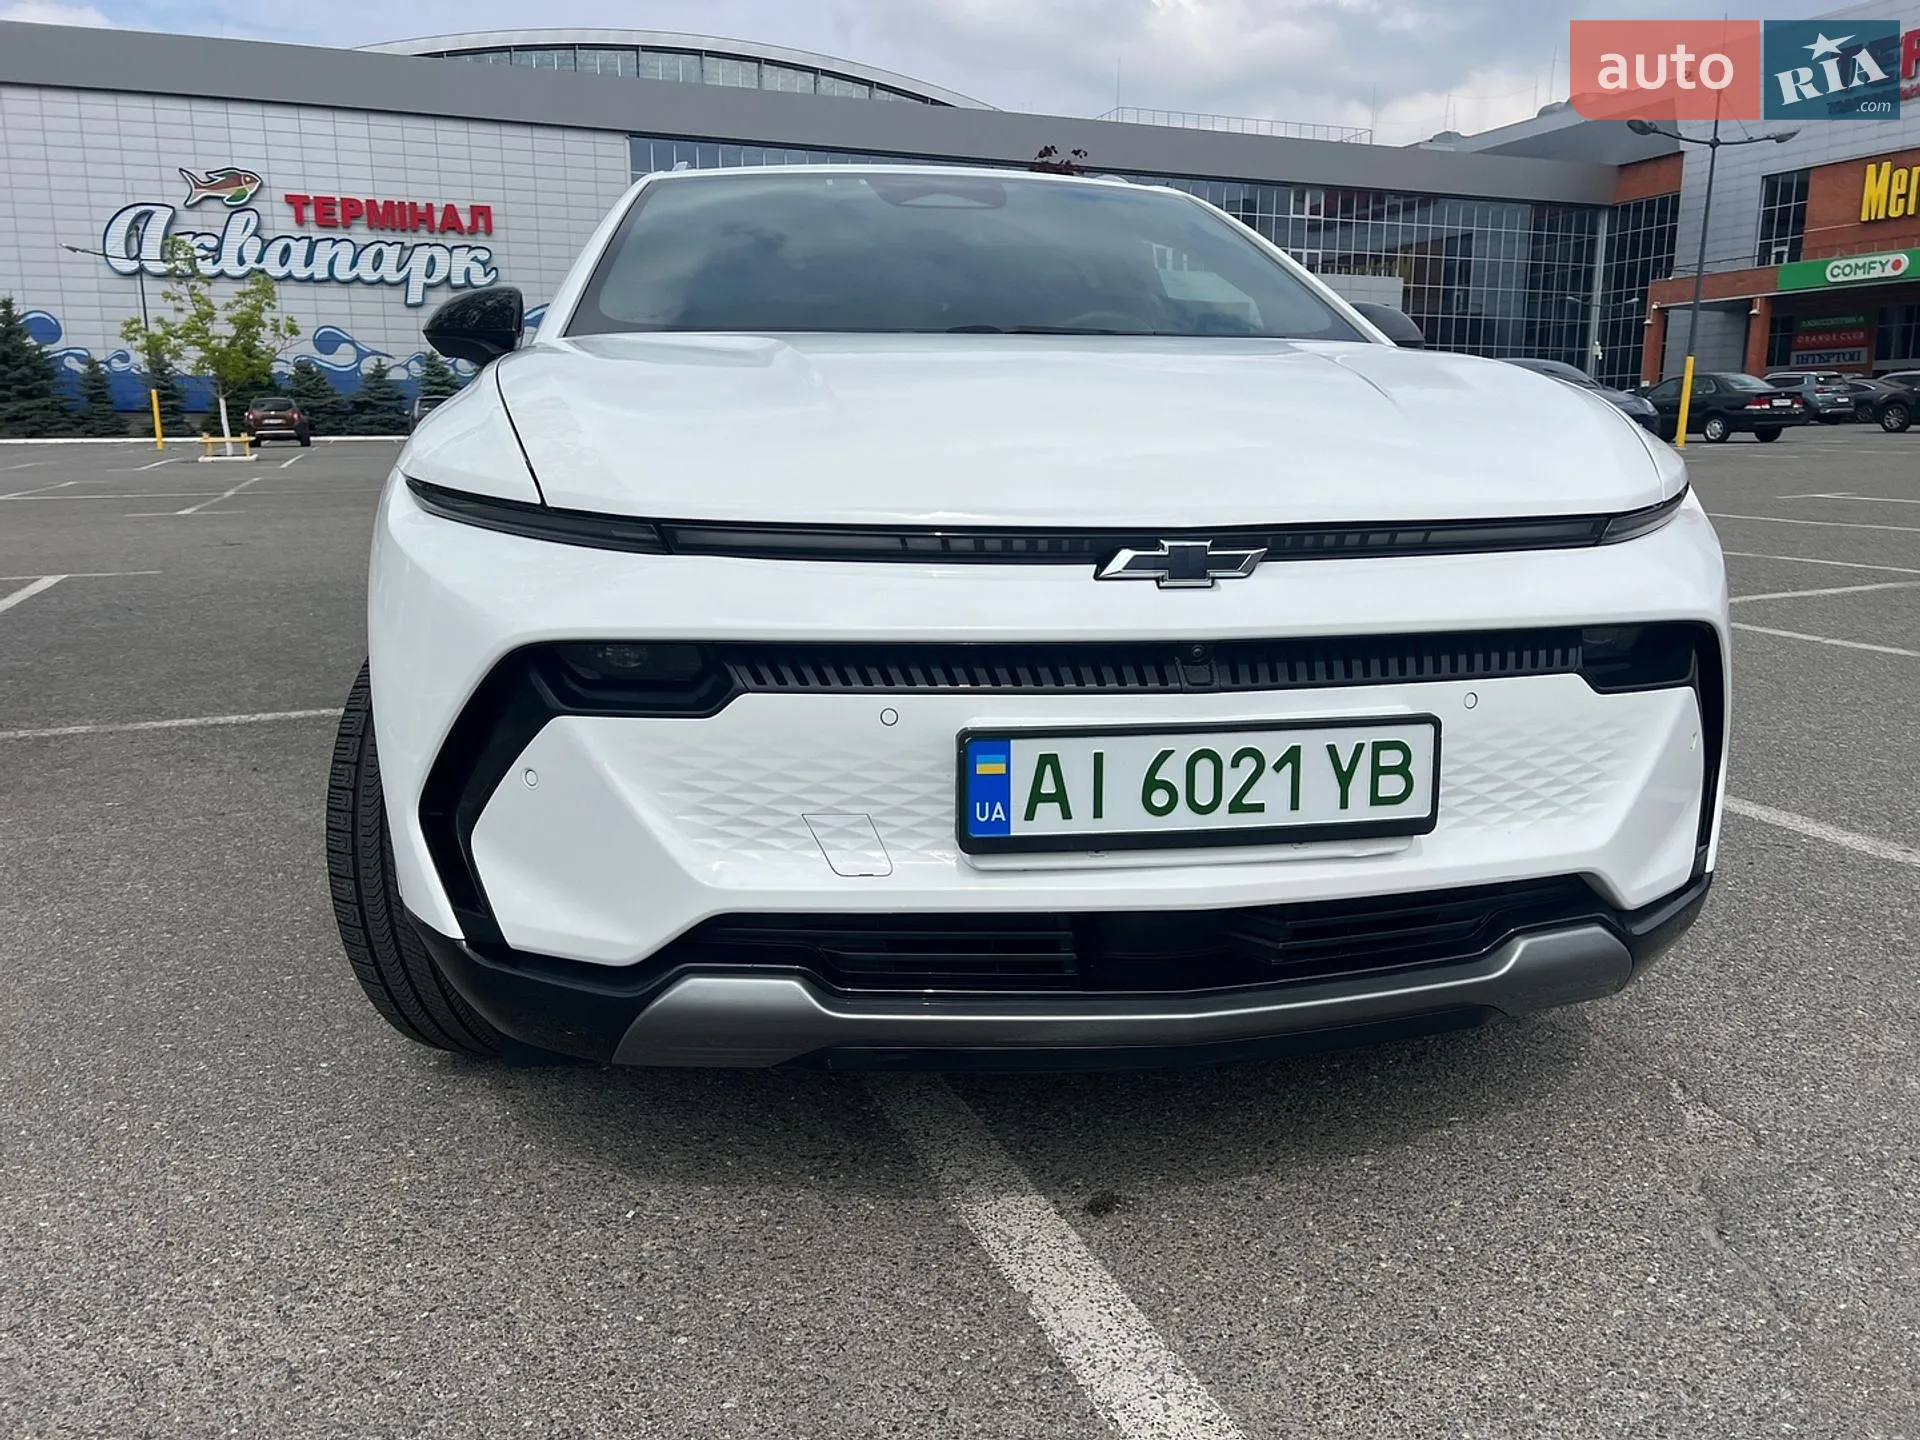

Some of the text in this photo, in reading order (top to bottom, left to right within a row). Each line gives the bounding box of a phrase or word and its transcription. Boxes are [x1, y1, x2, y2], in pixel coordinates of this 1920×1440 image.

[285, 193, 493, 234] ТЕРМІНАЛ
[103, 202, 499, 306] Аквапарк
[1829, 259, 1891, 279] COMFY
[1024, 739, 1416, 822] AI 6021 YB
[976, 802, 1006, 822] UA
